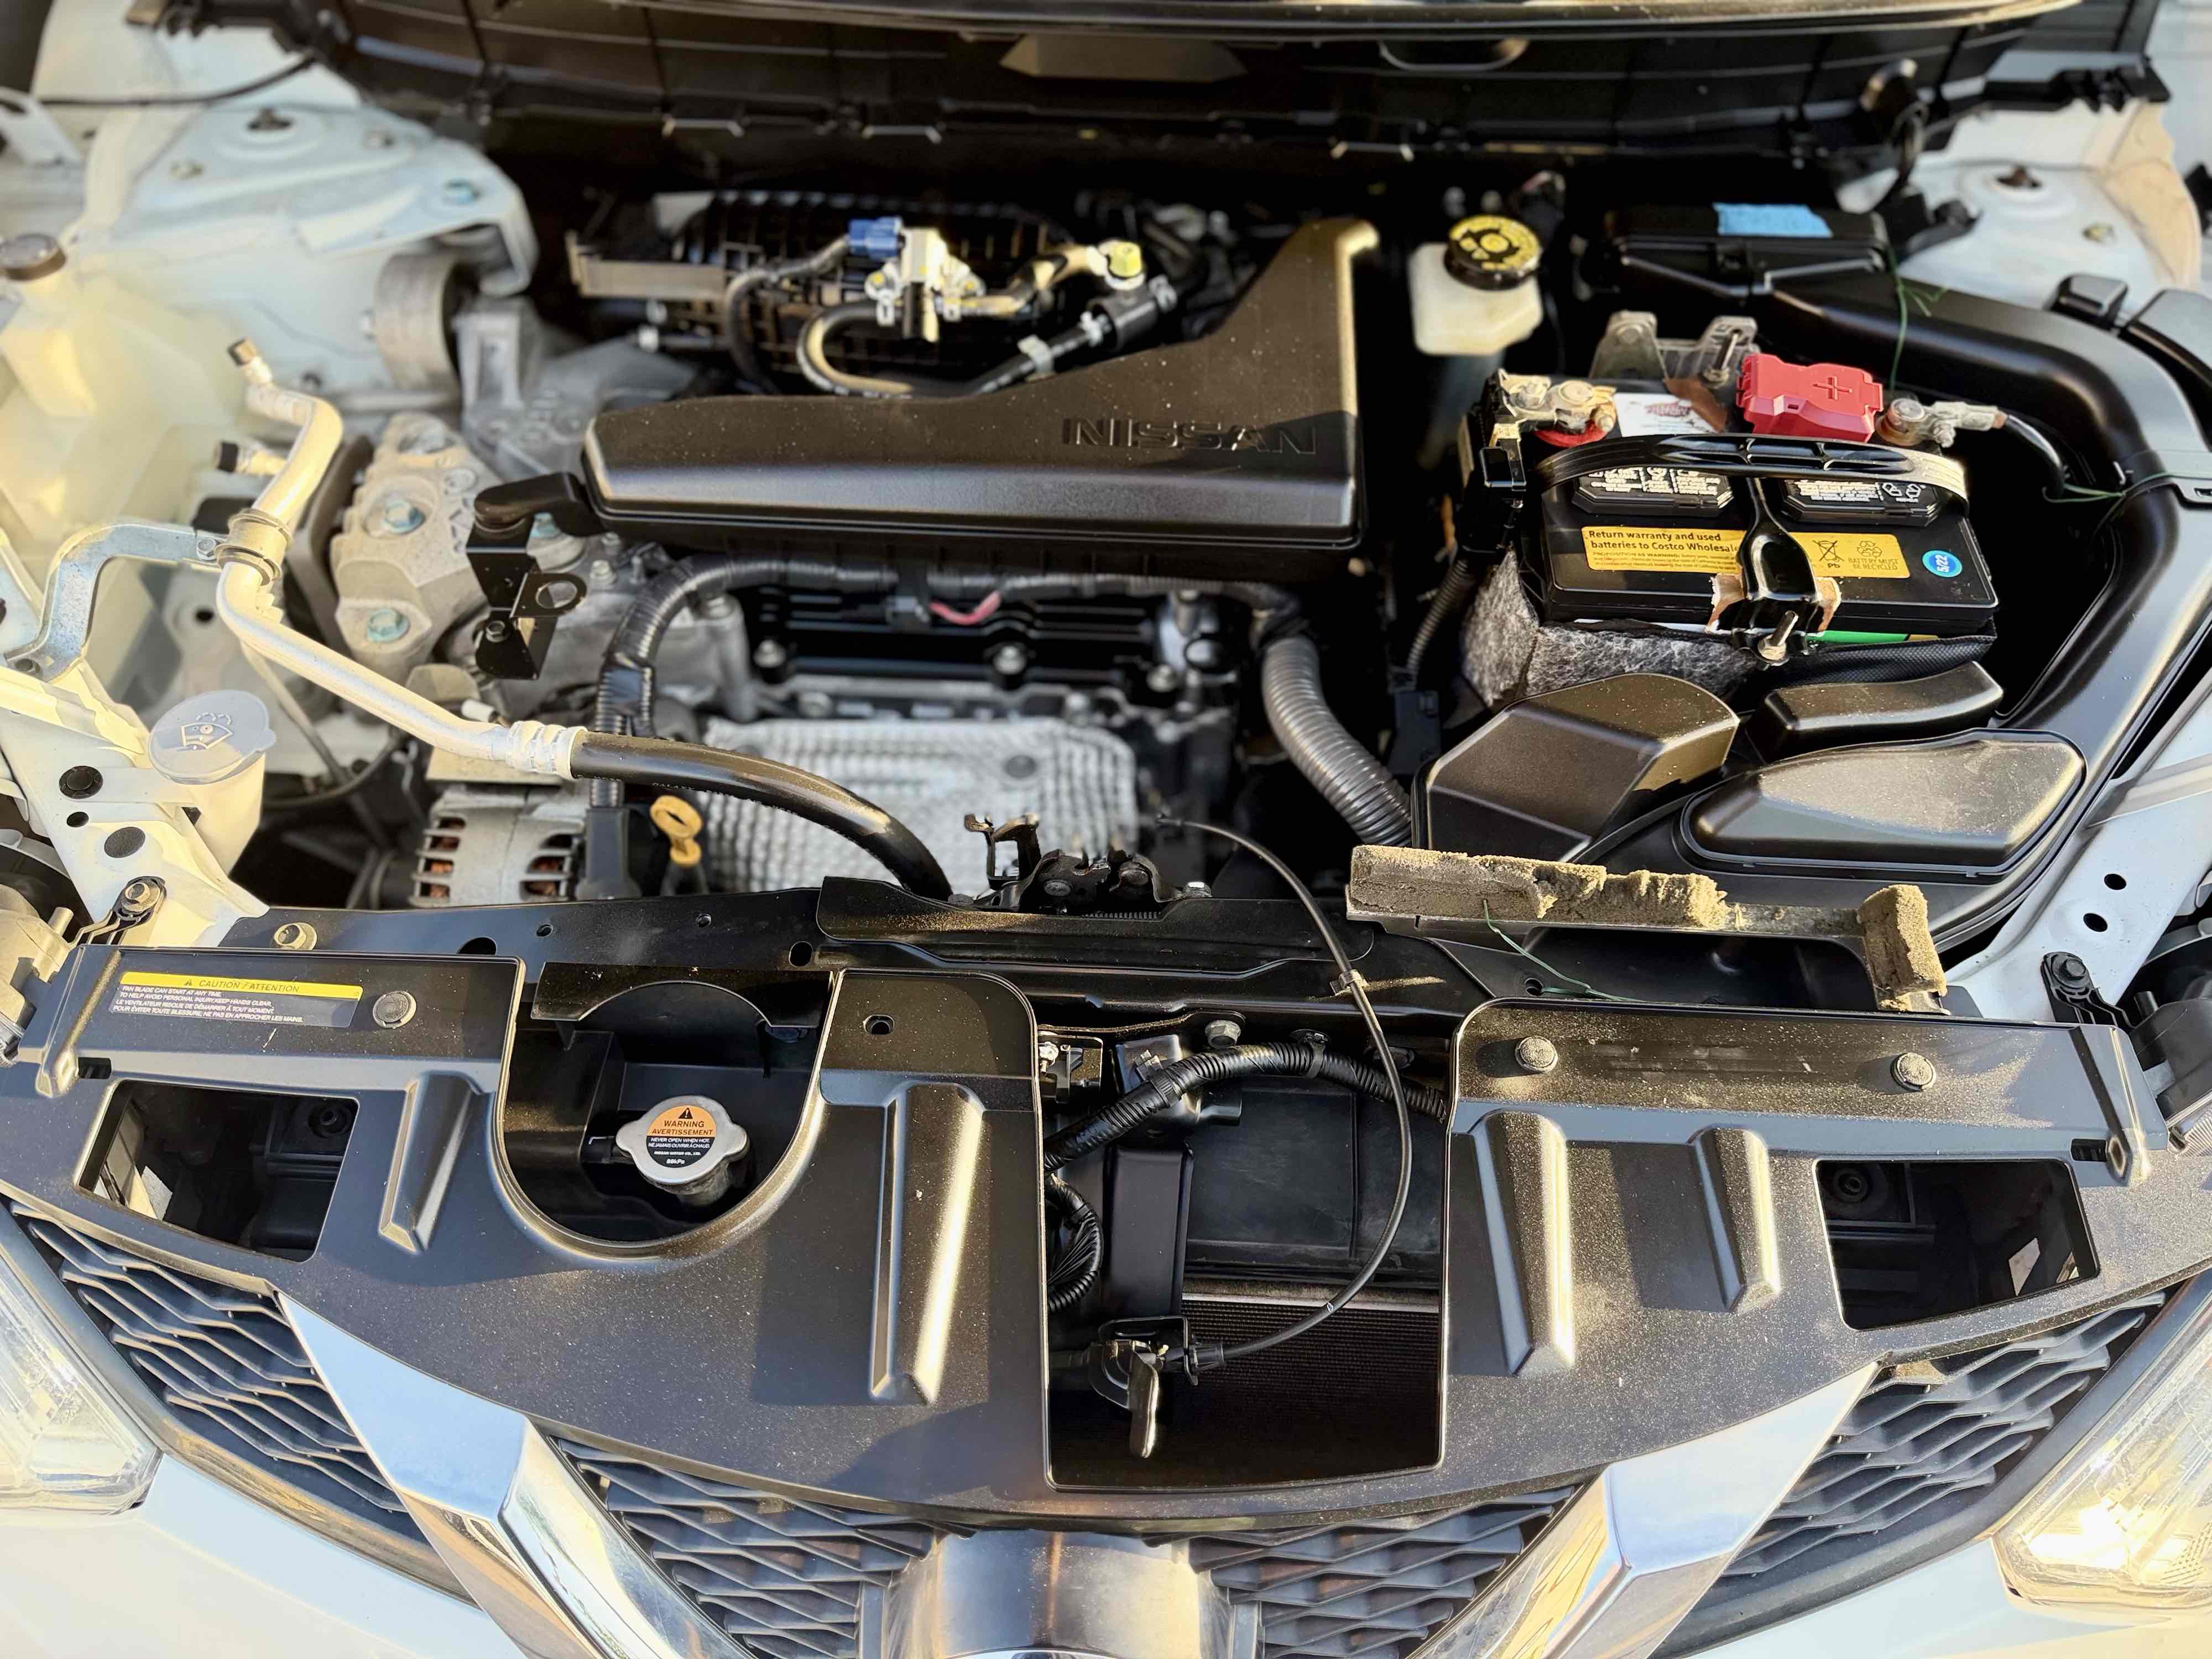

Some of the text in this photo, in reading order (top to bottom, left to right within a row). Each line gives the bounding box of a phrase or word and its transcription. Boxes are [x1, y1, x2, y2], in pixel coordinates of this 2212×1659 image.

[1063, 418, 1318, 455] NISSAN
[1626, 532, 1672, 542] warranty
[1590, 540, 1637, 549] batteries
[1935, 555, 1949, 573] 5/22
[199, 980, 239, 989] CAUTION
[249, 983, 299, 992] ATTENTION
